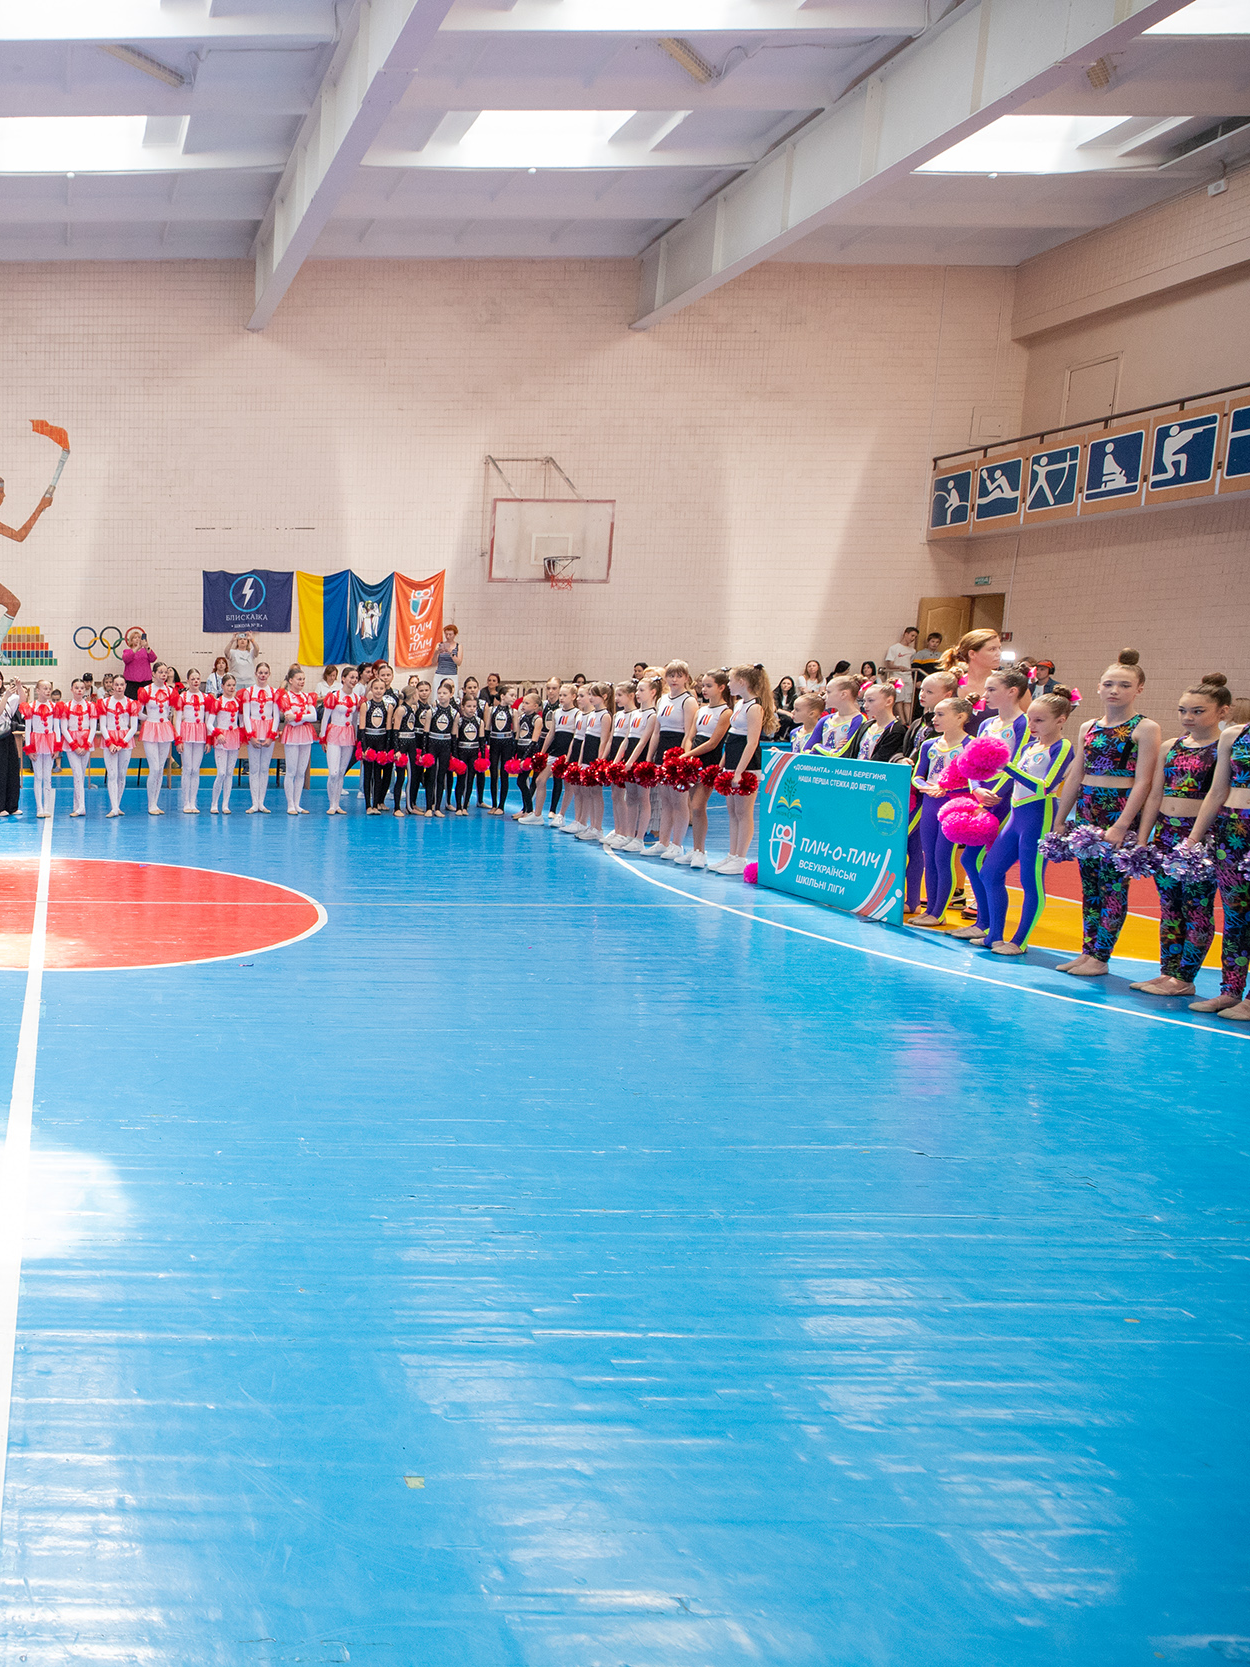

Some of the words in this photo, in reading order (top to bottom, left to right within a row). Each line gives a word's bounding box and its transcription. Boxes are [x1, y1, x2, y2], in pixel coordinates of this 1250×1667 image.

[410, 620, 432, 634] ПЛІЧ
[409, 638, 432, 652] ПЛІЧ
[794, 764, 830, 774] «ДОМІНАНТА»
[853, 771, 888, 781] БЕРЕГИНЯ,
[798, 775, 811, 783] НАША
[812, 777, 829, 785] ПЕРША
[830, 779, 850, 788] СТЕЖКА
[850, 782, 858, 790] ДО
[859, 784, 875, 792] МЕТИ!
[800, 837, 882, 869] ПЛІЧ-О-ПЛІЧ
[798, 859, 857, 882] ВСЕУКРАЇНСЬКІ
[795, 874, 827, 889] ШКІЛЬНІ
[827, 881, 846, 895] ЛІГИ
